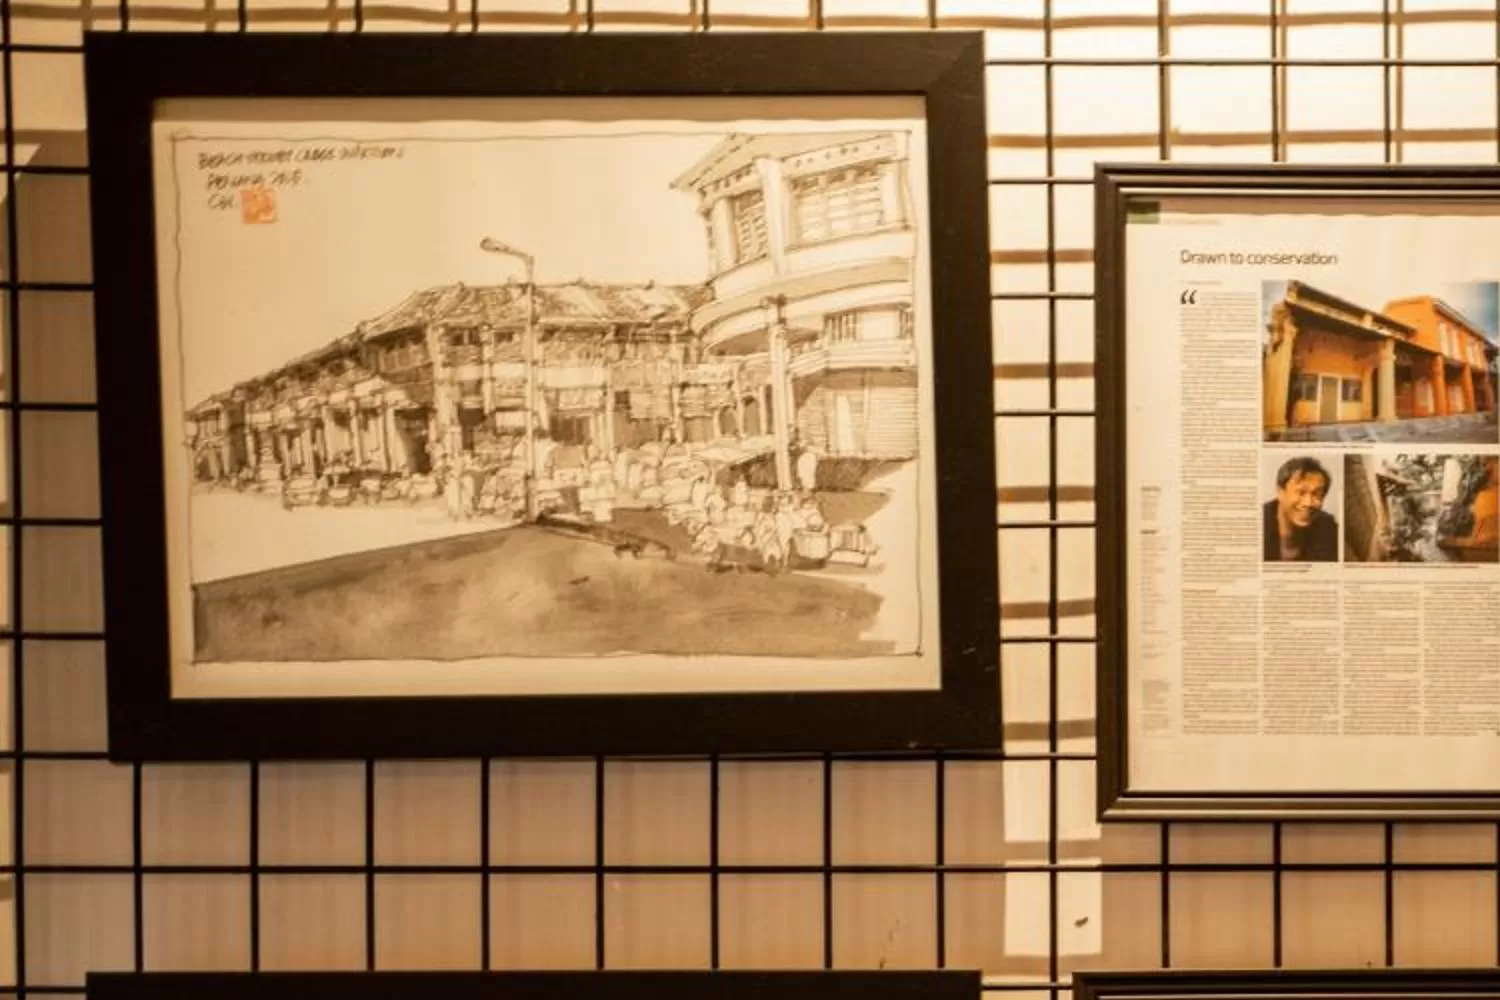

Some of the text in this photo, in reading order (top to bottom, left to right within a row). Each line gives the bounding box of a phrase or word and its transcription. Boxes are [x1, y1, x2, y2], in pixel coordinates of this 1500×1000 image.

[1180, 250, 1338, 265] Drawn to conservation
